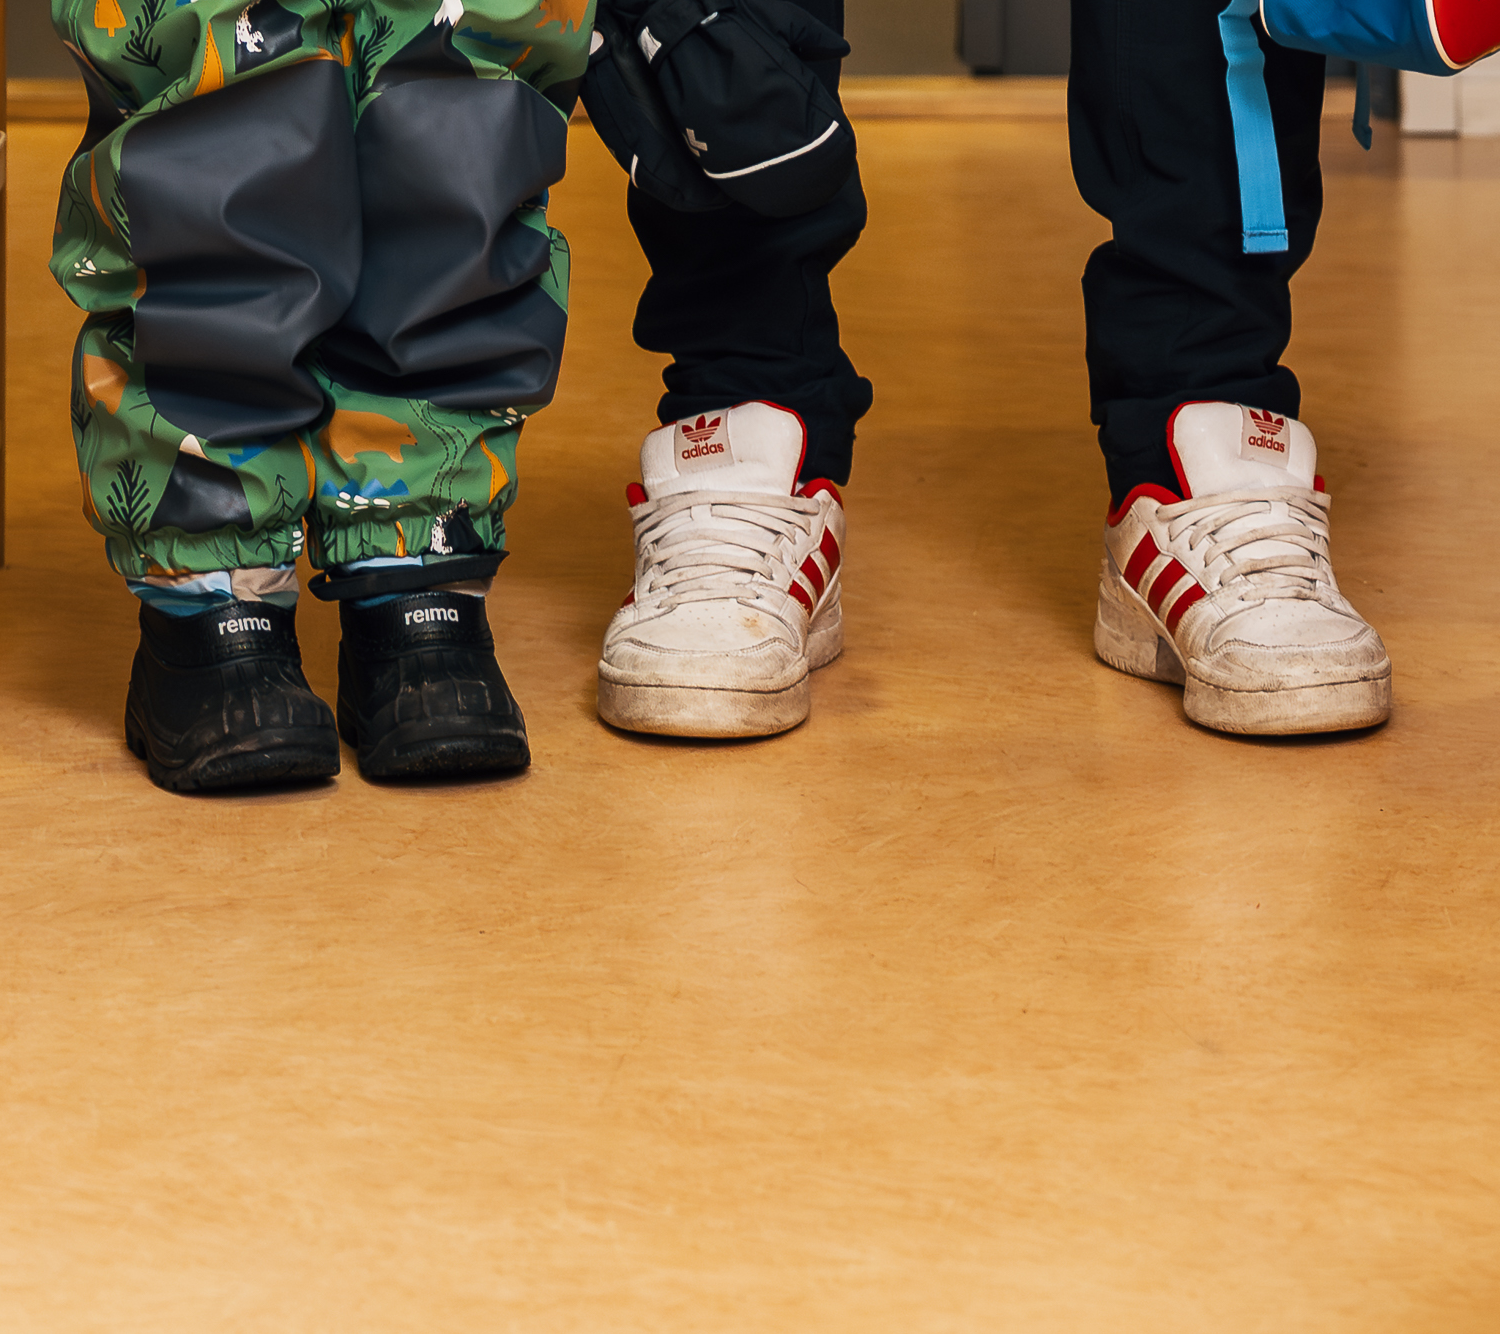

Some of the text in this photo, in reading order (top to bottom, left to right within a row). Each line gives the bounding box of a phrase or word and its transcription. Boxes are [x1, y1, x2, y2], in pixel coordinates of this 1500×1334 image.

[681, 442, 725, 460] adidas
[1248, 434, 1285, 453] adidas
[218, 616, 271, 635] reima
[404, 607, 459, 626] reima
